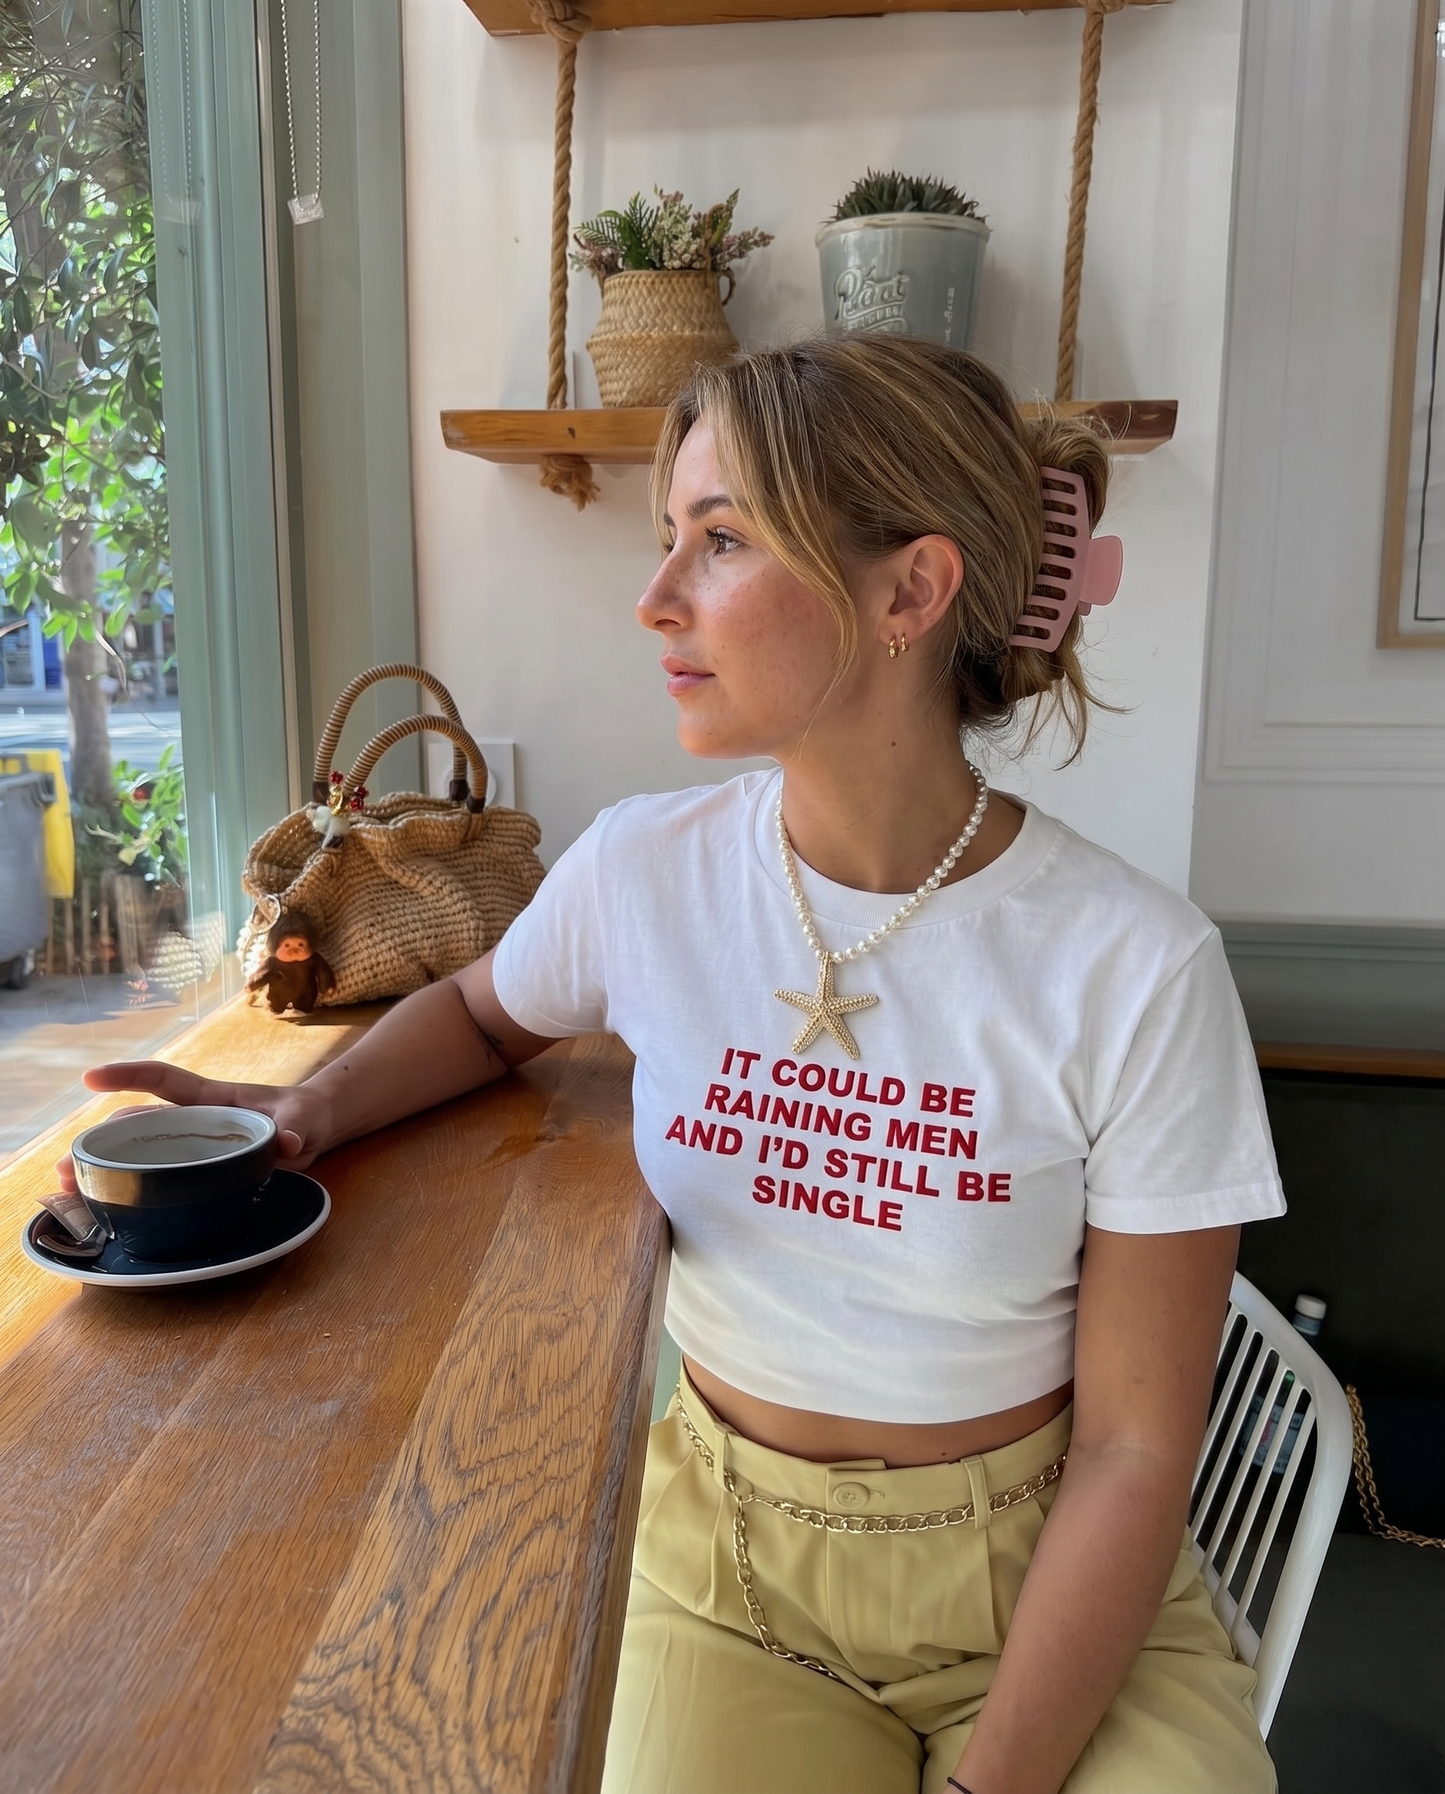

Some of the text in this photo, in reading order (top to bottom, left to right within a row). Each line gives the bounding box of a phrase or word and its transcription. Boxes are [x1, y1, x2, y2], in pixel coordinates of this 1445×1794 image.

[721, 1048, 976, 1118] IT COULD BE
[704, 1083, 978, 1160] RAINING MEN
[665, 1115, 1012, 1203] AND I'D STILL BE
[752, 1175, 903, 1232] SINGLE
